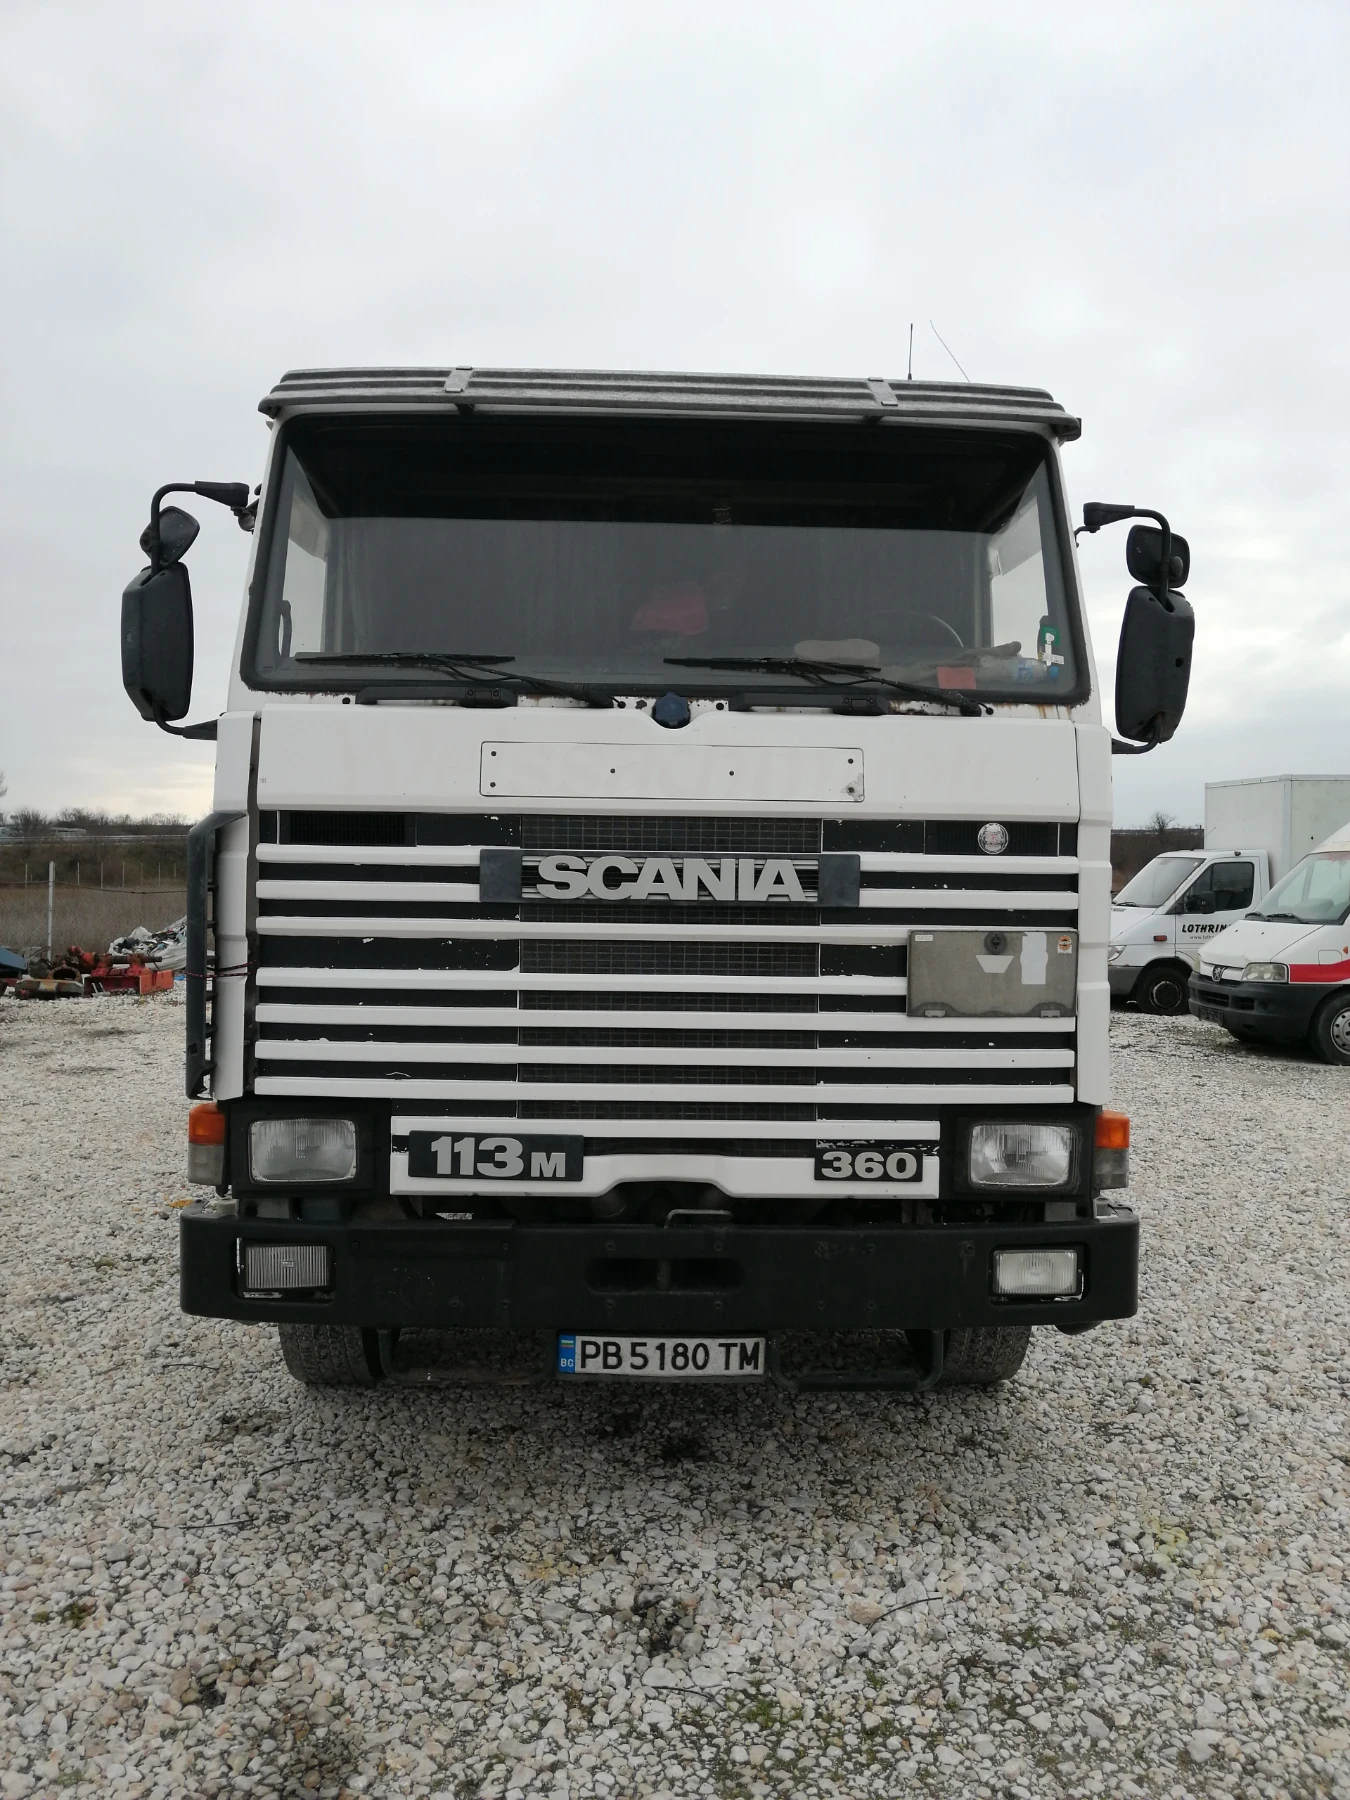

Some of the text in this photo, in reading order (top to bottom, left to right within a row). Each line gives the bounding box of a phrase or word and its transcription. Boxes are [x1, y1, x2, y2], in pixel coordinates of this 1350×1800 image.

[536, 855, 806, 902] SCANIA
[1182, 924, 1232, 933] LOTHRIN
[431, 1136, 566, 1178] 113 M
[821, 1151, 917, 1179] 360
[560, 1358, 574, 1367] BG
